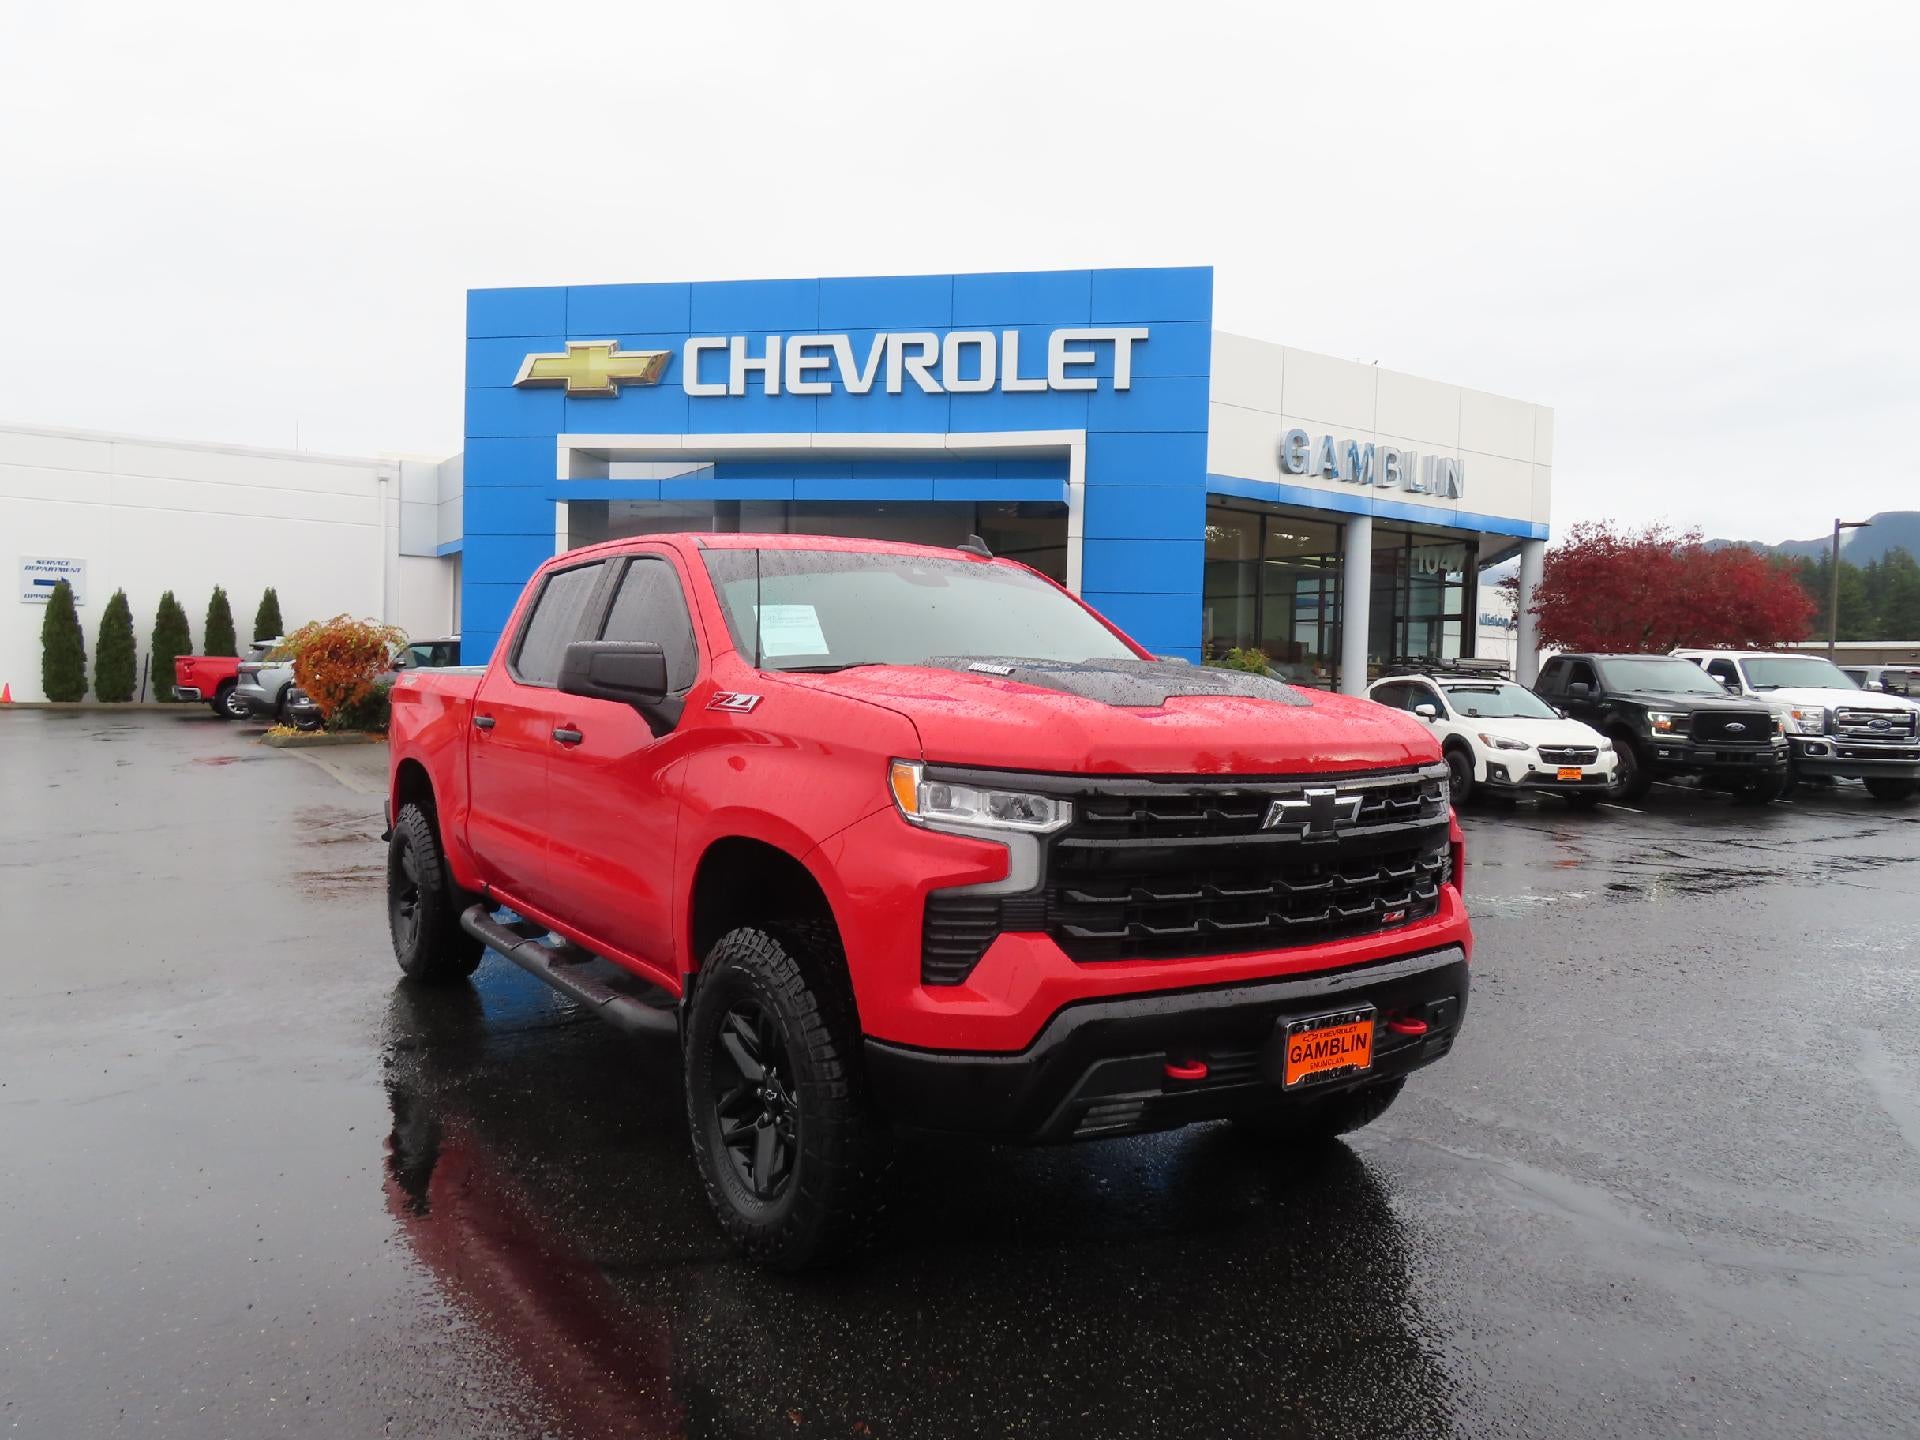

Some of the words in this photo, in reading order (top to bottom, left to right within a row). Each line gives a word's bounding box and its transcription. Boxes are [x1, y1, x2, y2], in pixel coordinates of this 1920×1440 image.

[683, 328, 1149, 396] CHEVROLET
[1280, 428, 1464, 499] GAMBLIN
[24, 565, 81, 573] DEPARTMENT
[1479, 612, 1510, 627] llision
[705, 691, 760, 713] Z71
[1319, 1025, 1357, 1038] CHEVROLET
[1290, 1032, 1368, 1064] GAMBLIN
[1310, 1056, 1345, 1070] ENUMCLAW
